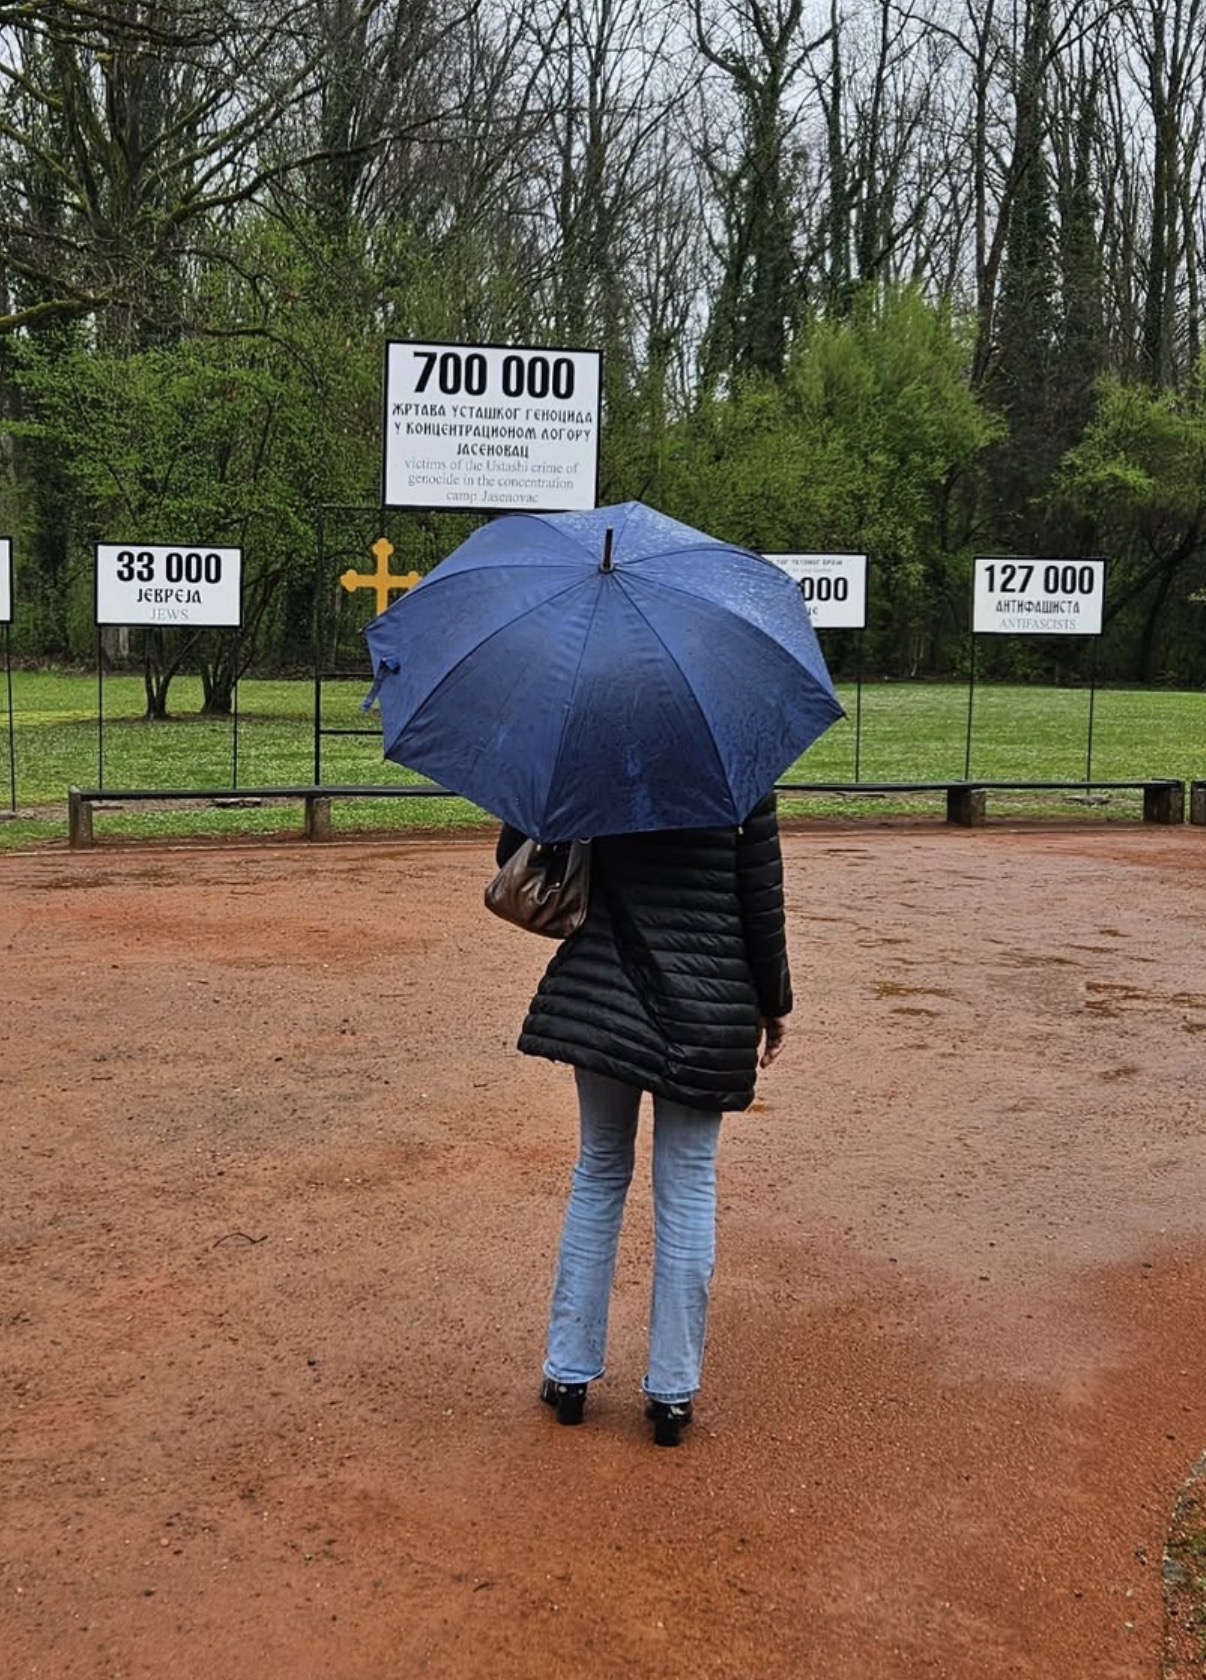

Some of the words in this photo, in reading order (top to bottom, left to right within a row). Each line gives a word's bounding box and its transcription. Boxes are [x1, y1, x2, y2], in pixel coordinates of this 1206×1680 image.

[413, 352, 487, 396] 700
[502, 355, 575, 399] 000
[392, 402, 446, 417] ЖРТАВА
[452, 405, 521, 420] УСТАШКОГ
[526, 409, 593, 424] ГЕНОЦИДА
[394, 422, 401, 435] У
[406, 422, 537, 440] КОНЦЕНТРАЦИОНОМ
[541, 428, 592, 443] ЛОГОРУ
[457, 443, 530, 459] ЈАСЕНОВАЦ
[404, 458, 447, 470] victims
[450, 459, 464, 471] of
[465, 459, 483, 472] the
[486, 460, 528, 473] Ustashi
[531, 462, 563, 474] crime
[566, 462, 579, 474] of
[408, 472, 460, 487] genocide
[463, 473, 475, 486] in
[477, 474, 495, 487] the
[497, 476, 574, 489] concentration
[446, 492, 478, 504] camp
[482, 491, 539, 504] Jasenovac
[117, 551, 155, 582] 33
[166, 552, 222, 584] 000
[984, 564, 1034, 593] 127
[1044, 565, 1094, 595] 000
[136, 588, 202, 604] ЈЕВРЕЈА
[801, 577, 848, 602] 000
[149, 608, 190, 620] JEWS
[996, 600, 1080, 614] АНТИФАШИСТА
[999, 618, 1076, 630] ANTIFASCISTS
